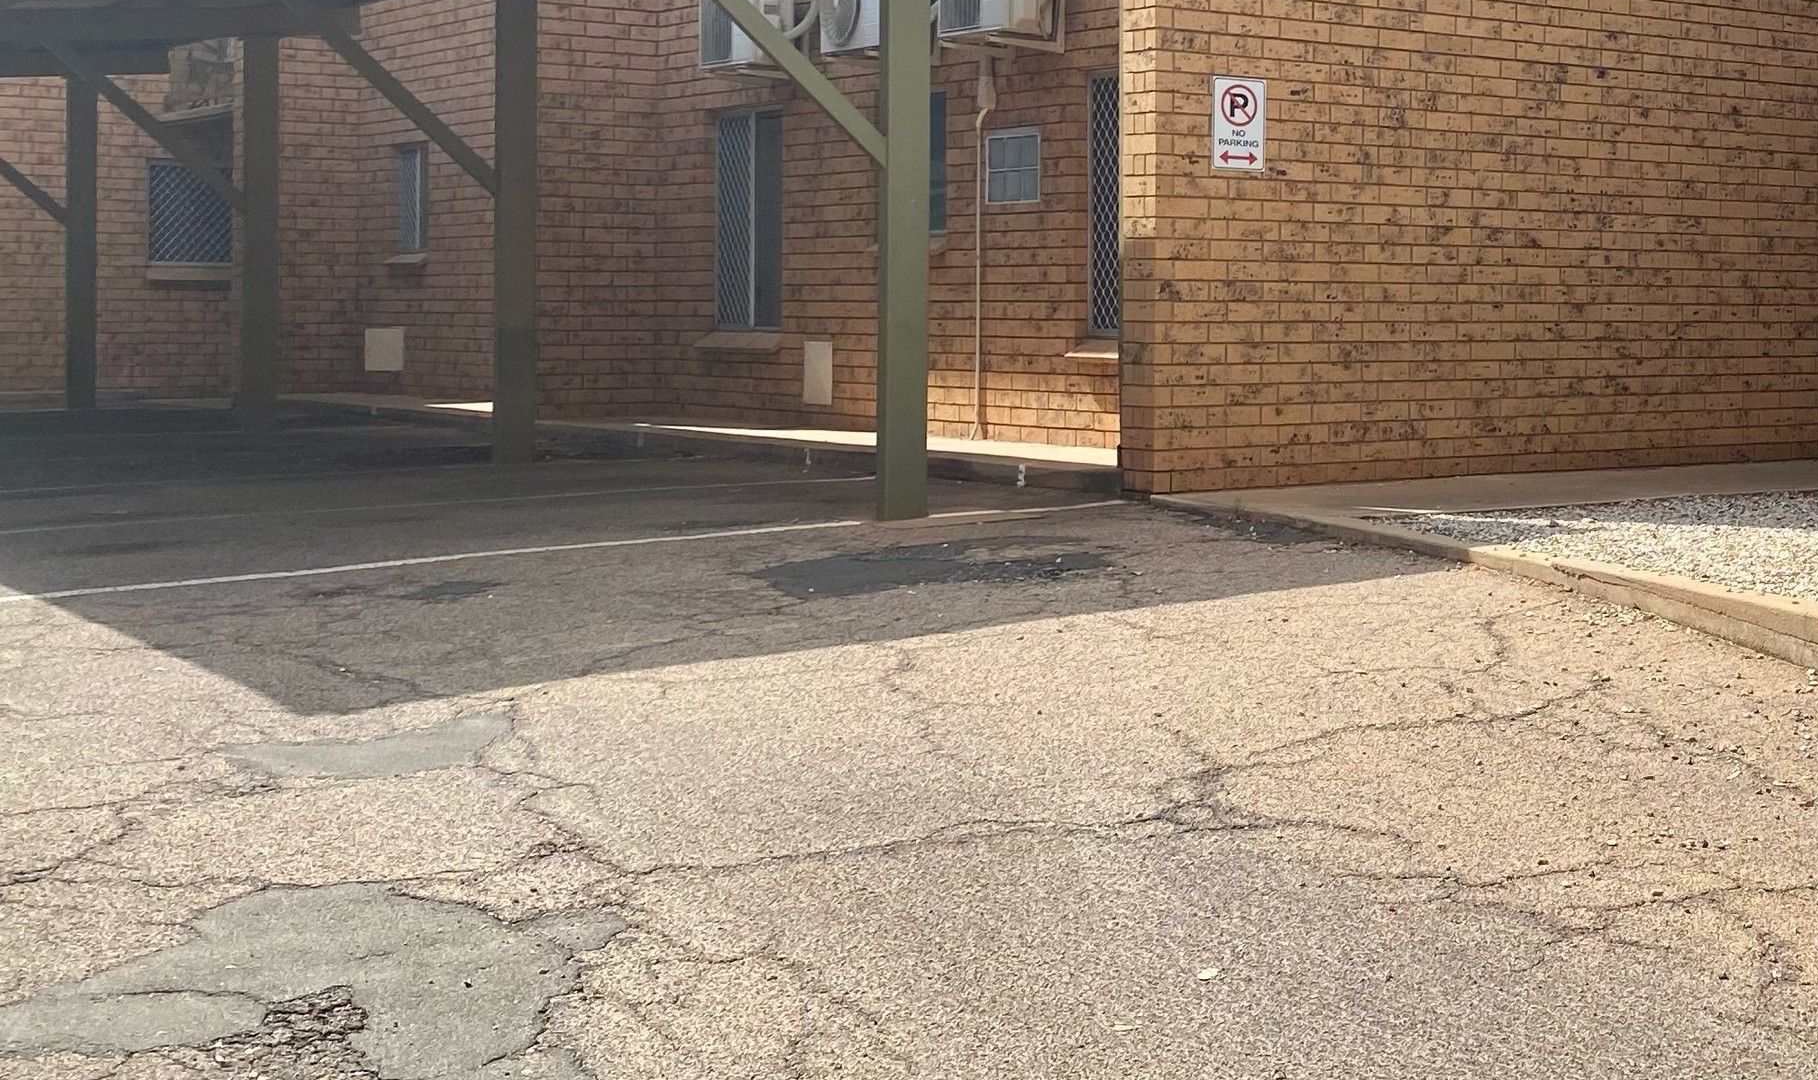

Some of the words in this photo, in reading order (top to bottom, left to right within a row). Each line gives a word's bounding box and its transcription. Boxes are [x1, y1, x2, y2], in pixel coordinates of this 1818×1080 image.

[1229, 93, 1249, 117] P
[1231, 129, 1246, 137] NO
[1218, 138, 1259, 148] PARKING
